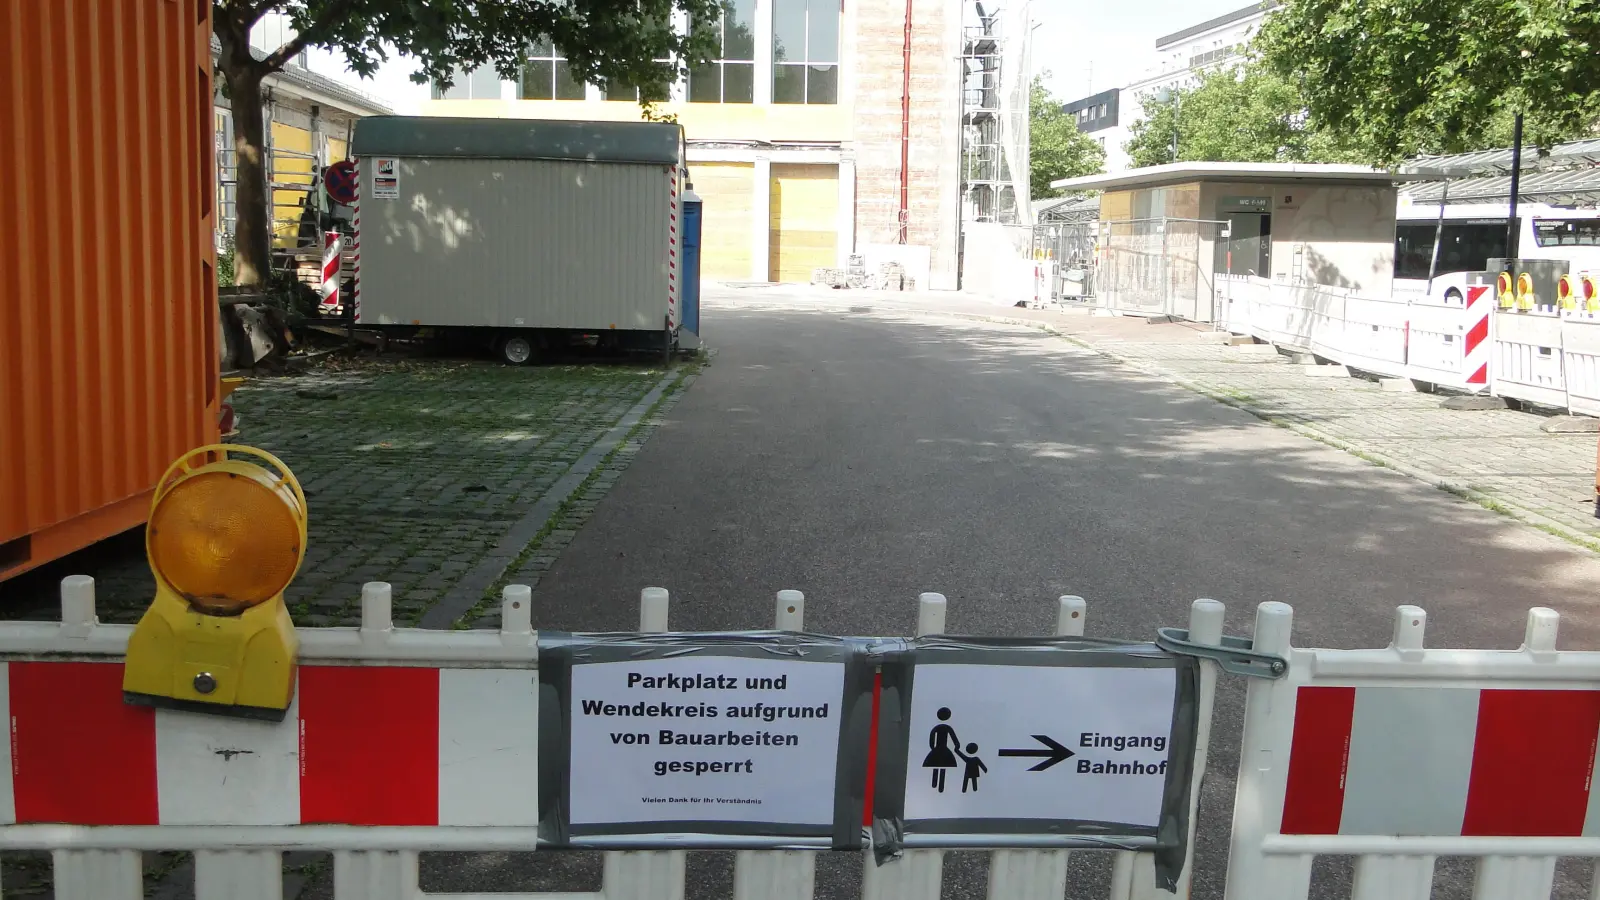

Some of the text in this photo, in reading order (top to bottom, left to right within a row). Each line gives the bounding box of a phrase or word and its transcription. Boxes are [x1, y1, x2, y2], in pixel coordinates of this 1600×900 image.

[344, 238, 352, 246] 20
[627, 672, 788, 693] Parkplatz und
[581, 699, 829, 722] Wendekreis aufgrund
[609, 729, 799, 746] von Bauarbeiten
[1079, 732, 1167, 752] Eingang
[653, 758, 753, 776] gesperrt
[1076, 759, 1167, 775] Bahnhof
[716, 797, 762, 805] Verständnis
